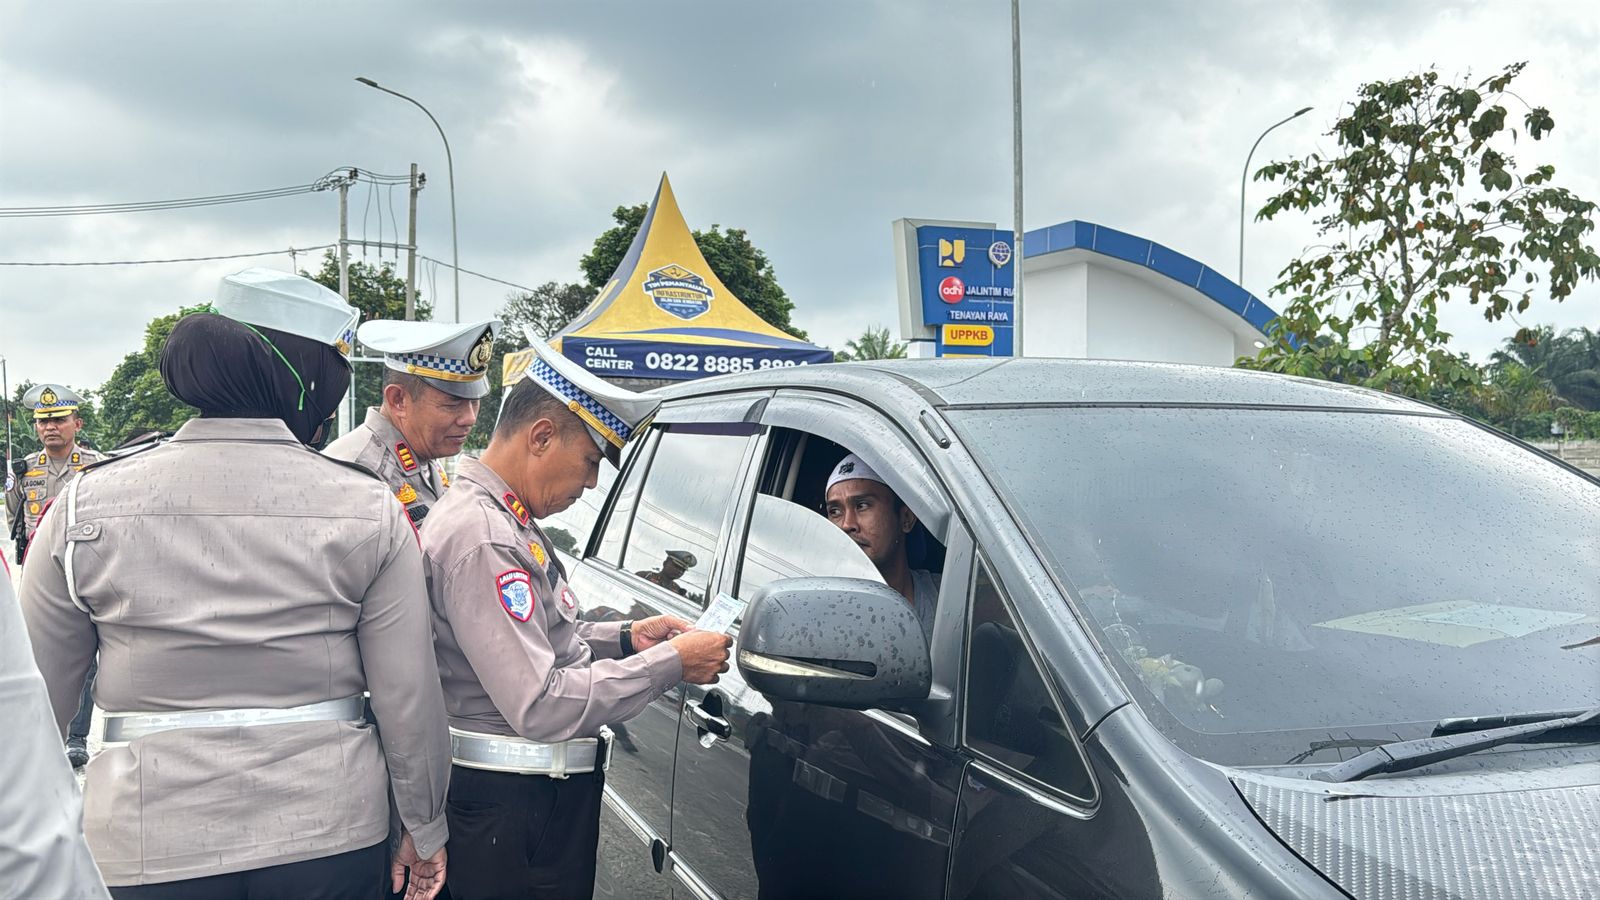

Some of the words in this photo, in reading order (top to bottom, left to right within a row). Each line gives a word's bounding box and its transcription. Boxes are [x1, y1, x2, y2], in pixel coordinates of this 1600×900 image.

[943, 286, 963, 295] adhi
[966, 286, 1002, 296] JALINTIM
[1003, 287, 1015, 297] RIA
[950, 310, 986, 320] TENAYAN
[988, 311, 1008, 321] RAYA
[950, 329, 988, 340] UPPKB
[585, 346, 618, 358] CALL
[585, 358, 634, 370] CENTER
[645, 352, 699, 372] 0822
[703, 355, 754, 373] 8885
